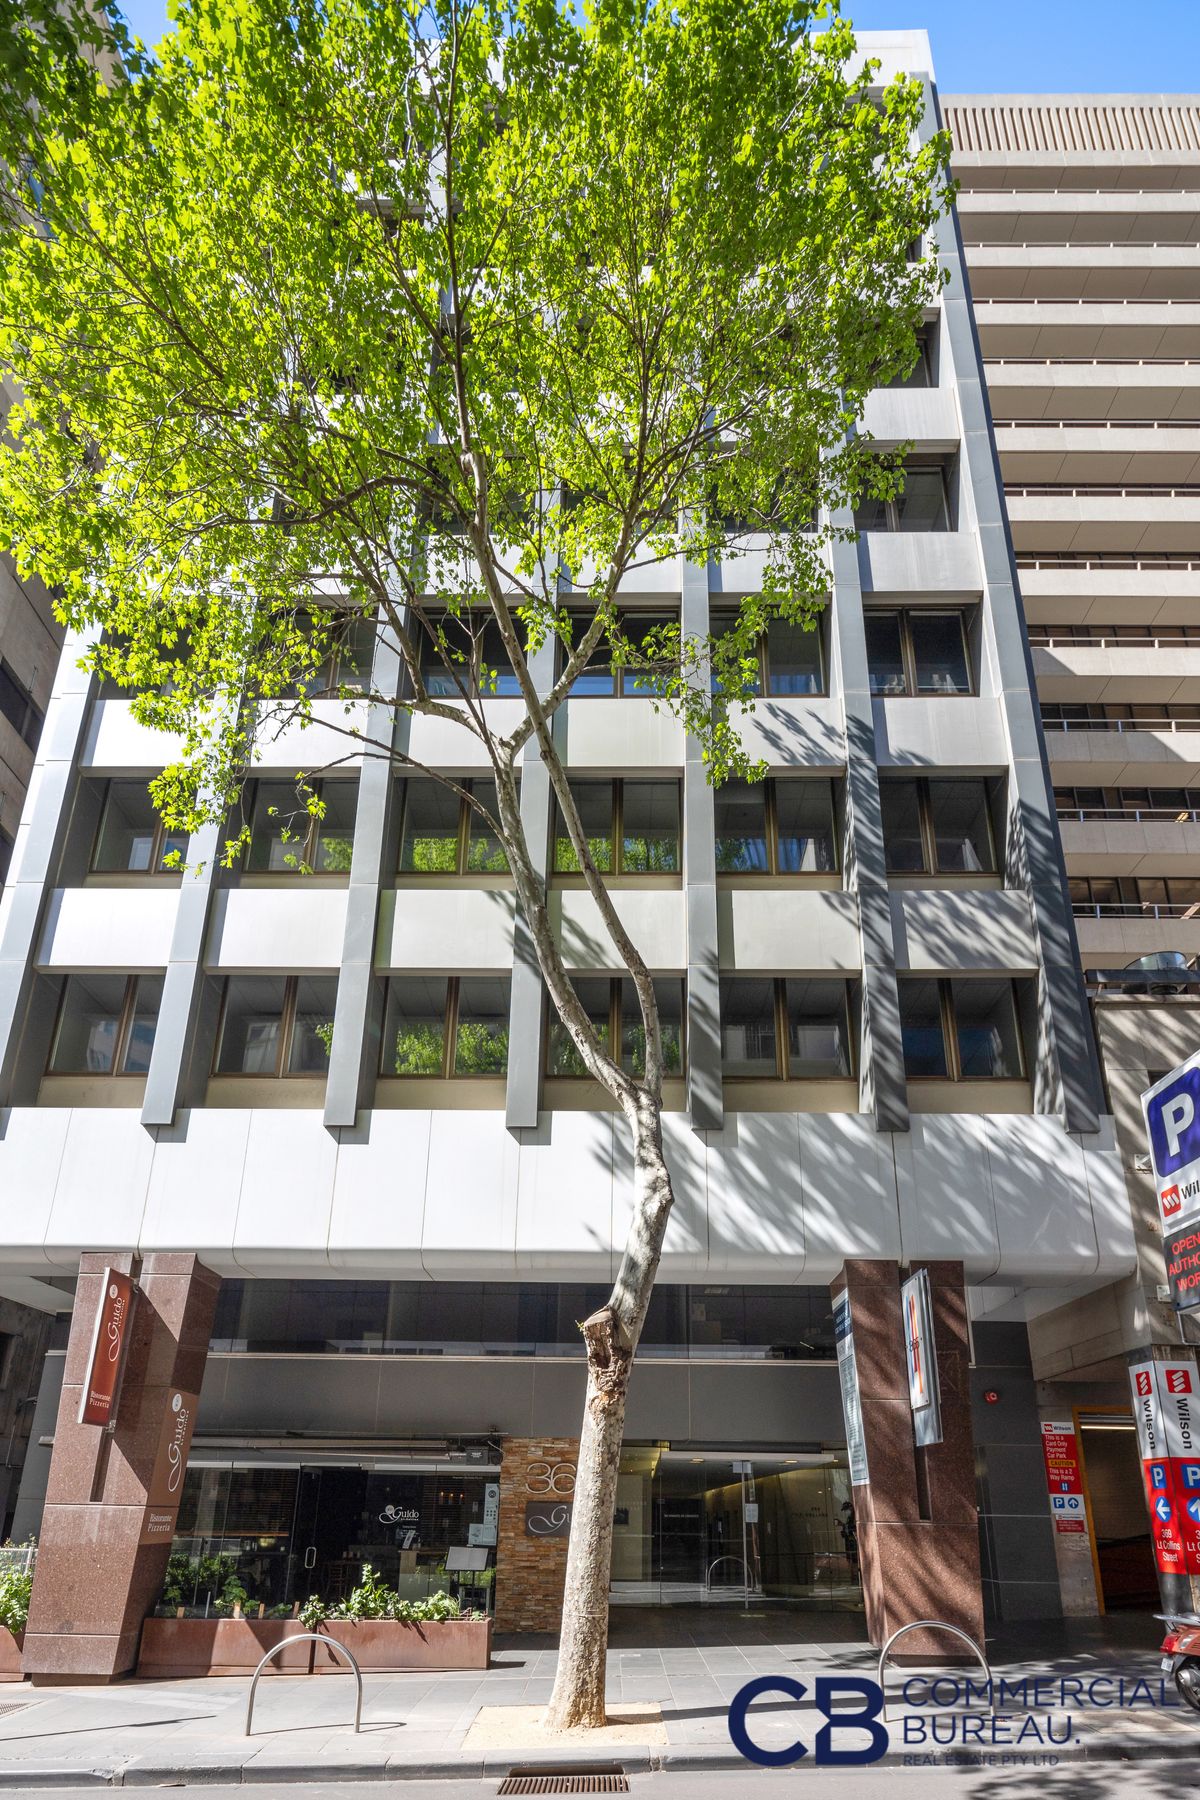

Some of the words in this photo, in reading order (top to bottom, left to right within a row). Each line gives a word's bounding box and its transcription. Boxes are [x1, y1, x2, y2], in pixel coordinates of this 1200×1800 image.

[1161, 1093, 1195, 1157] P
[107, 1297, 122, 1362] Guido
[168, 1408, 186, 1492] Guido
[1143, 1398, 1156, 1450] Wilson
[1176, 1398, 1193, 1450] Wilson
[378, 1506, 420, 1524] Guido
